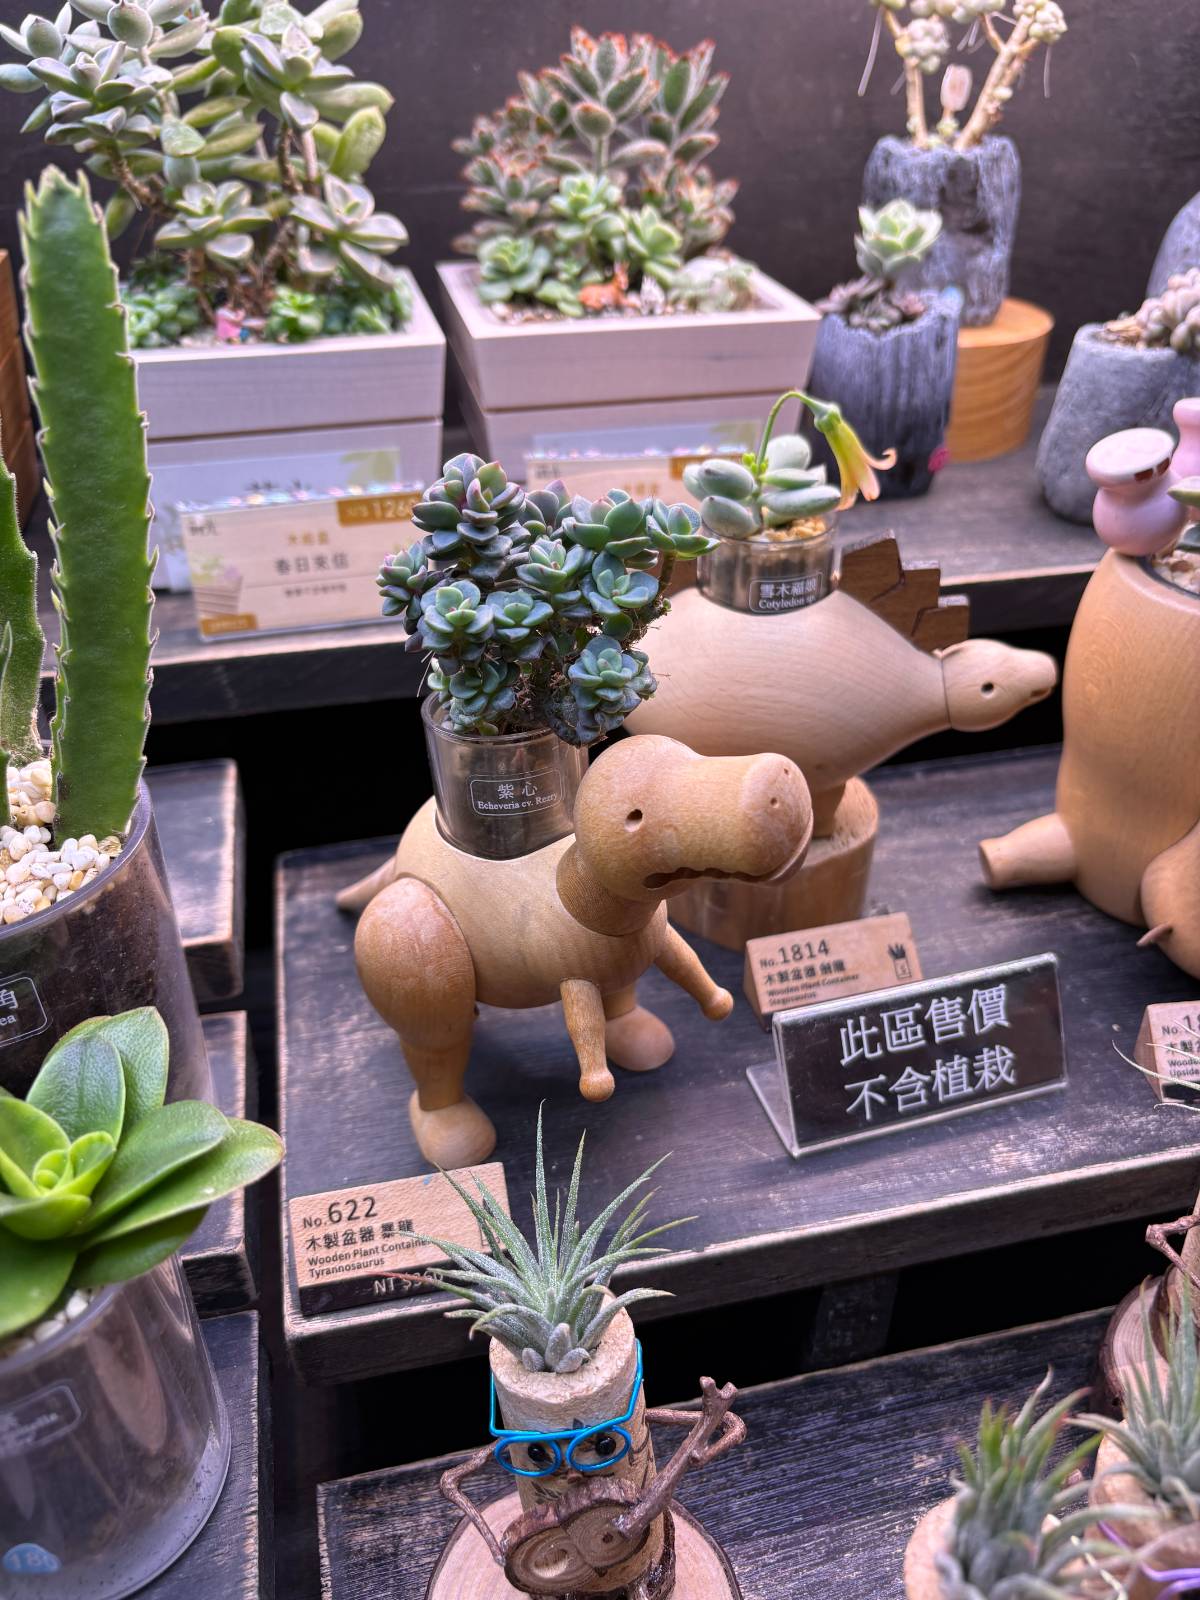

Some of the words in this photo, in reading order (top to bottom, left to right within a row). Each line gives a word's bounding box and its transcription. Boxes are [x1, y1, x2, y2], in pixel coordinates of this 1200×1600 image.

[758, 597, 805, 610] Cotyledon
[477, 800, 520, 810] Echeveria
[840, 983, 1011, 1067] 此區售價
[844, 1044, 1017, 1121] 不含植栽
[306, 1225, 375, 1252] 木製盆器
[307, 1251, 351, 1267] Wooden
[352, 1246, 379, 1259] Plant
[309, 1257, 385, 1279] Tyrannosaurus
[373, 1278, 395, 1297] NT
